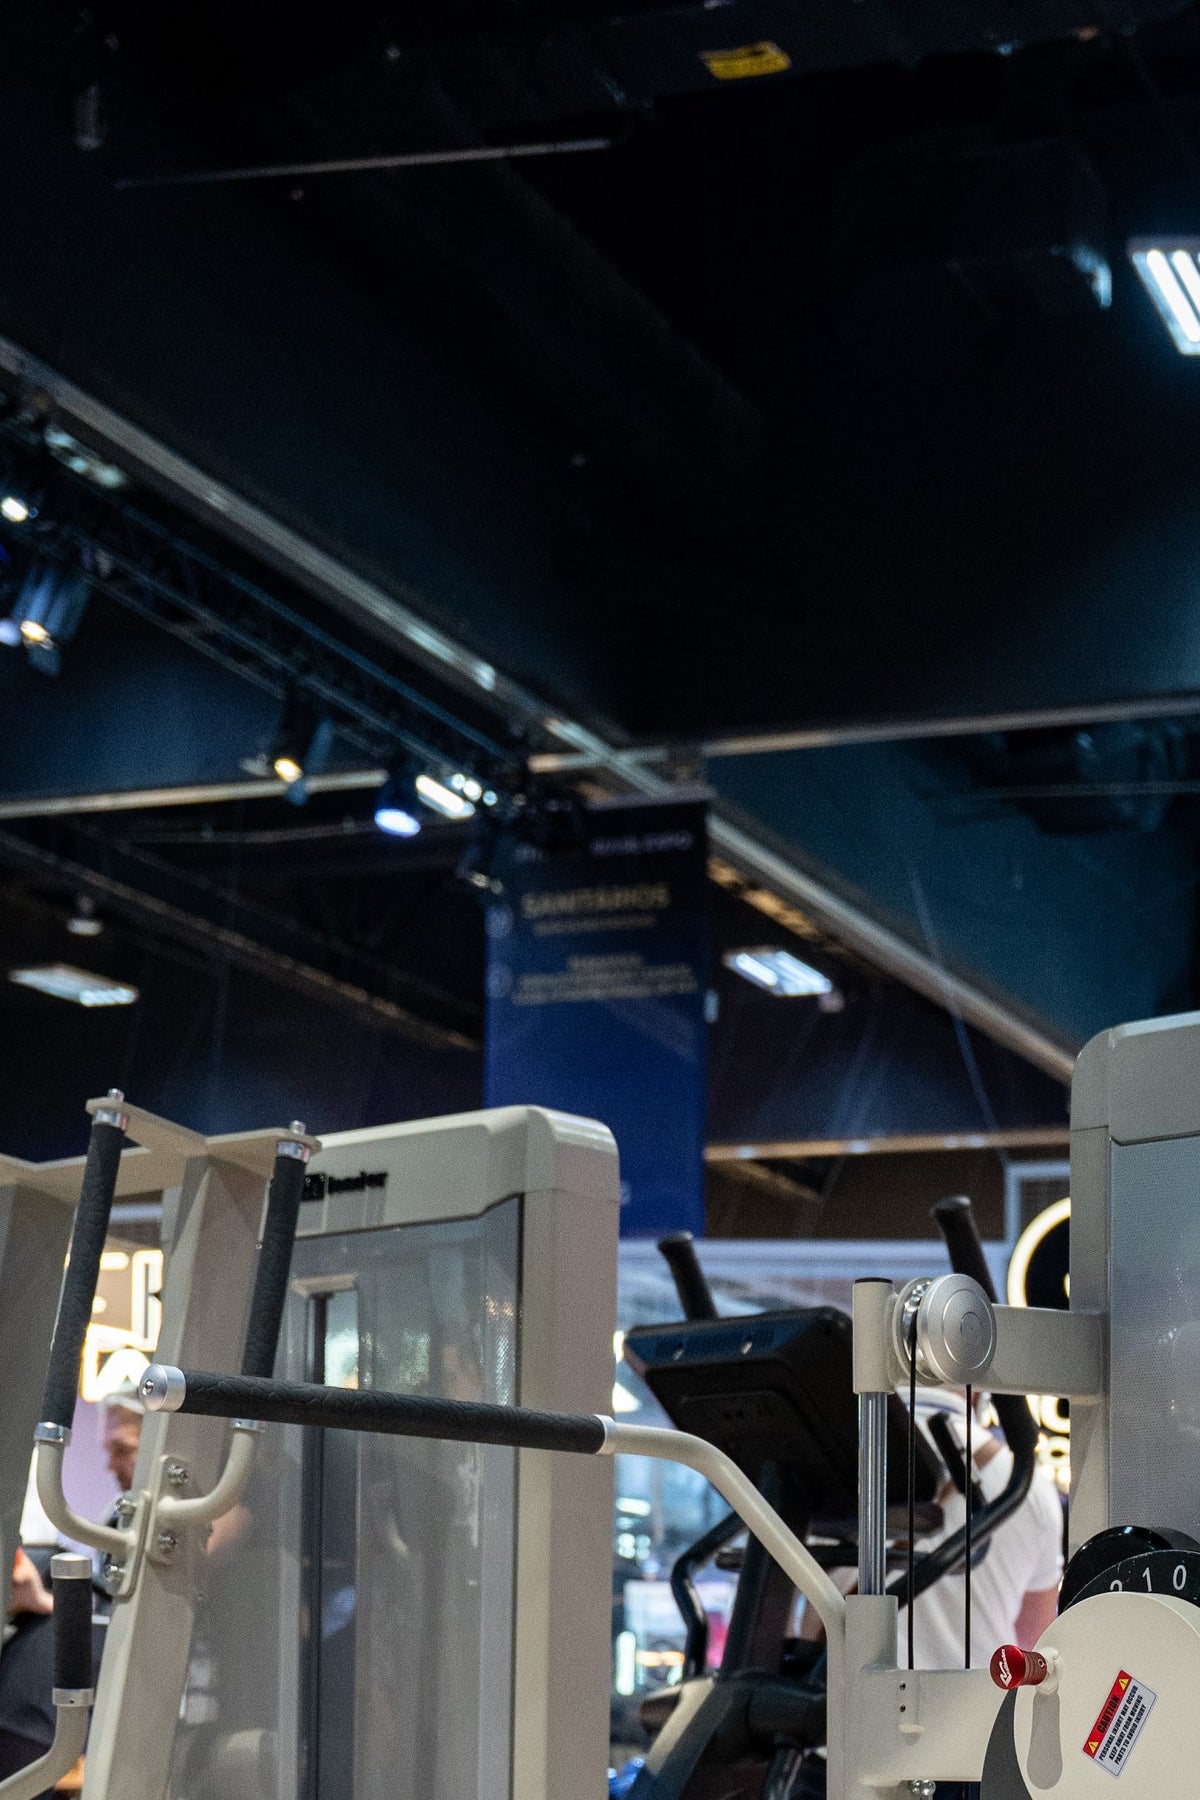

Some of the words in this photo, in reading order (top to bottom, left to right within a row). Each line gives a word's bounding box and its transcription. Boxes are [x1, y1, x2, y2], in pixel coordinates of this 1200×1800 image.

[1142, 1567, 1152, 1592] 1
[1173, 1564, 1187, 1591] 0
[1096, 1694, 1121, 1734] CAUTION
[1099, 1734, 1115, 1761] PERSONAL
[1111, 1715, 1123, 1735] INJURY
[1121, 1704, 1129, 1716] MAY
[1126, 1685, 1138, 1705] OCCUR
[1108, 1746, 1118, 1760] KEEP
[1115, 1731, 1126, 1748] AWAY
[1122, 1716, 1133, 1732] FROM
[1129, 1695, 1143, 1717] MOVING
[1114, 1746, 1126, 1765] PARTS
[1126, 1723, 1138, 1740] AVOID
[1134, 1704, 1146, 1724] INJURY
